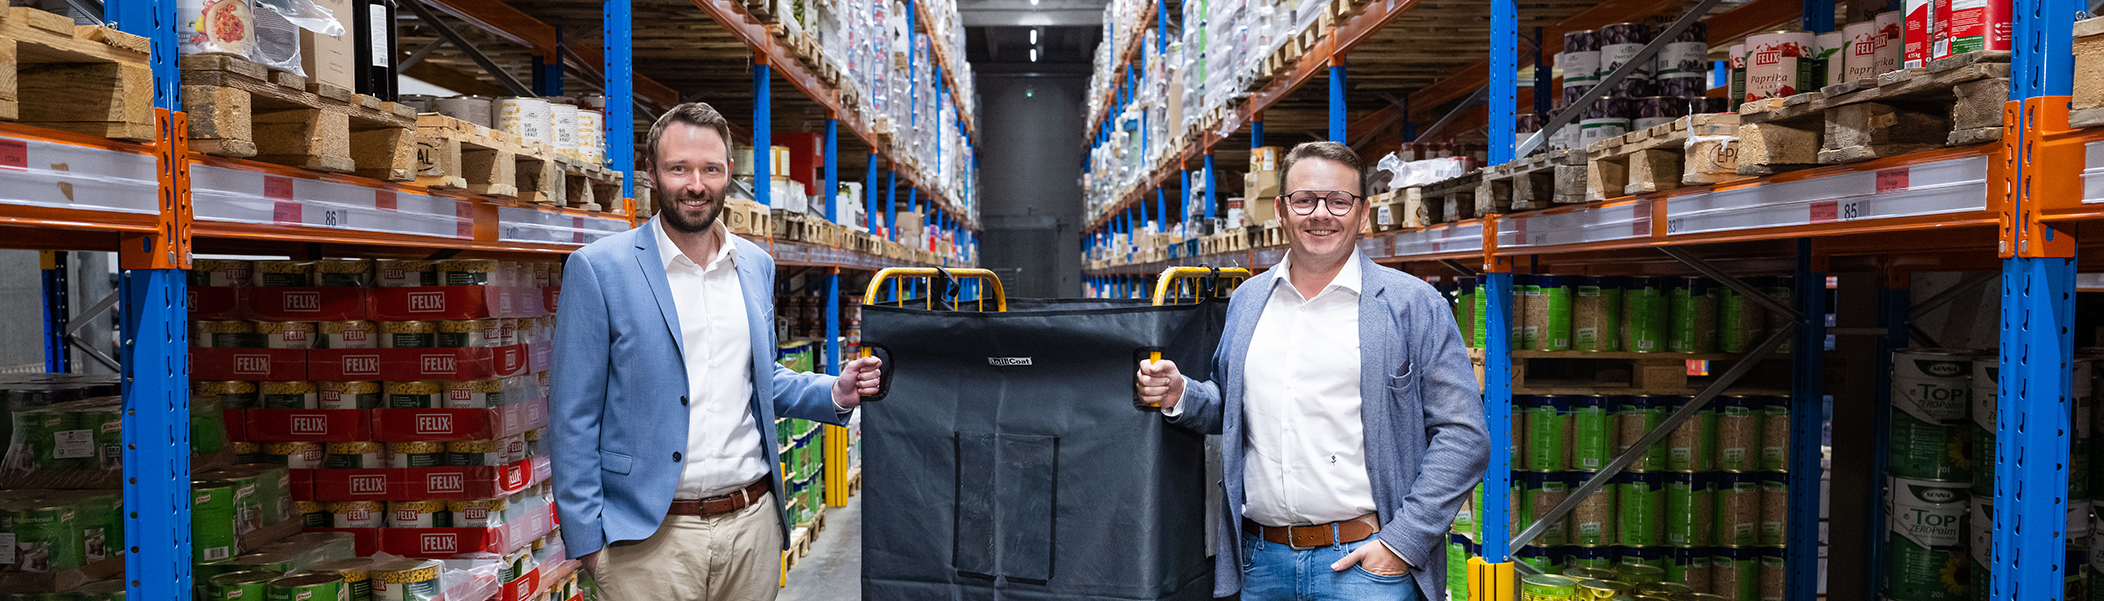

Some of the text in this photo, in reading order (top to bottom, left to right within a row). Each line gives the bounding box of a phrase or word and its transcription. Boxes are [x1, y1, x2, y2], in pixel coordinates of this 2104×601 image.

[1875, 35, 1887, 48] ELIX
[1856, 43, 1874, 55] FELI
[1757, 52, 1779, 64] FELIX
[1750, 74, 1788, 84] Paprika
[1717, 148, 1738, 163] EPA
[325, 210, 336, 226] 86
[1844, 203, 1858, 220] 85
[1668, 220, 1677, 233] 83
[384, 270, 404, 279] FELIX
[287, 295, 317, 308] FELIX
[411, 295, 441, 309] FELIX
[284, 331, 306, 340] FELIX
[345, 331, 366, 340] FELIX
[237, 357, 267, 371] FELIX
[346, 358, 377, 372] FELIX
[424, 357, 454, 371] FELIX
[323, 391, 340, 400] FELIX
[451, 390, 471, 400] FELIX
[294, 418, 324, 431] FELIX
[419, 417, 450, 430] FELIX
[353, 478, 383, 491] FELIX
[431, 476, 461, 490] FELIX
[1926, 491, 1951, 499] SENNA
[349, 511, 369, 520] FELIX
[397, 511, 417, 520] FELIX
[466, 509, 487, 519] FELIX
[1909, 524, 1957, 536] ZEROPalm
[424, 537, 455, 550] FELIX
